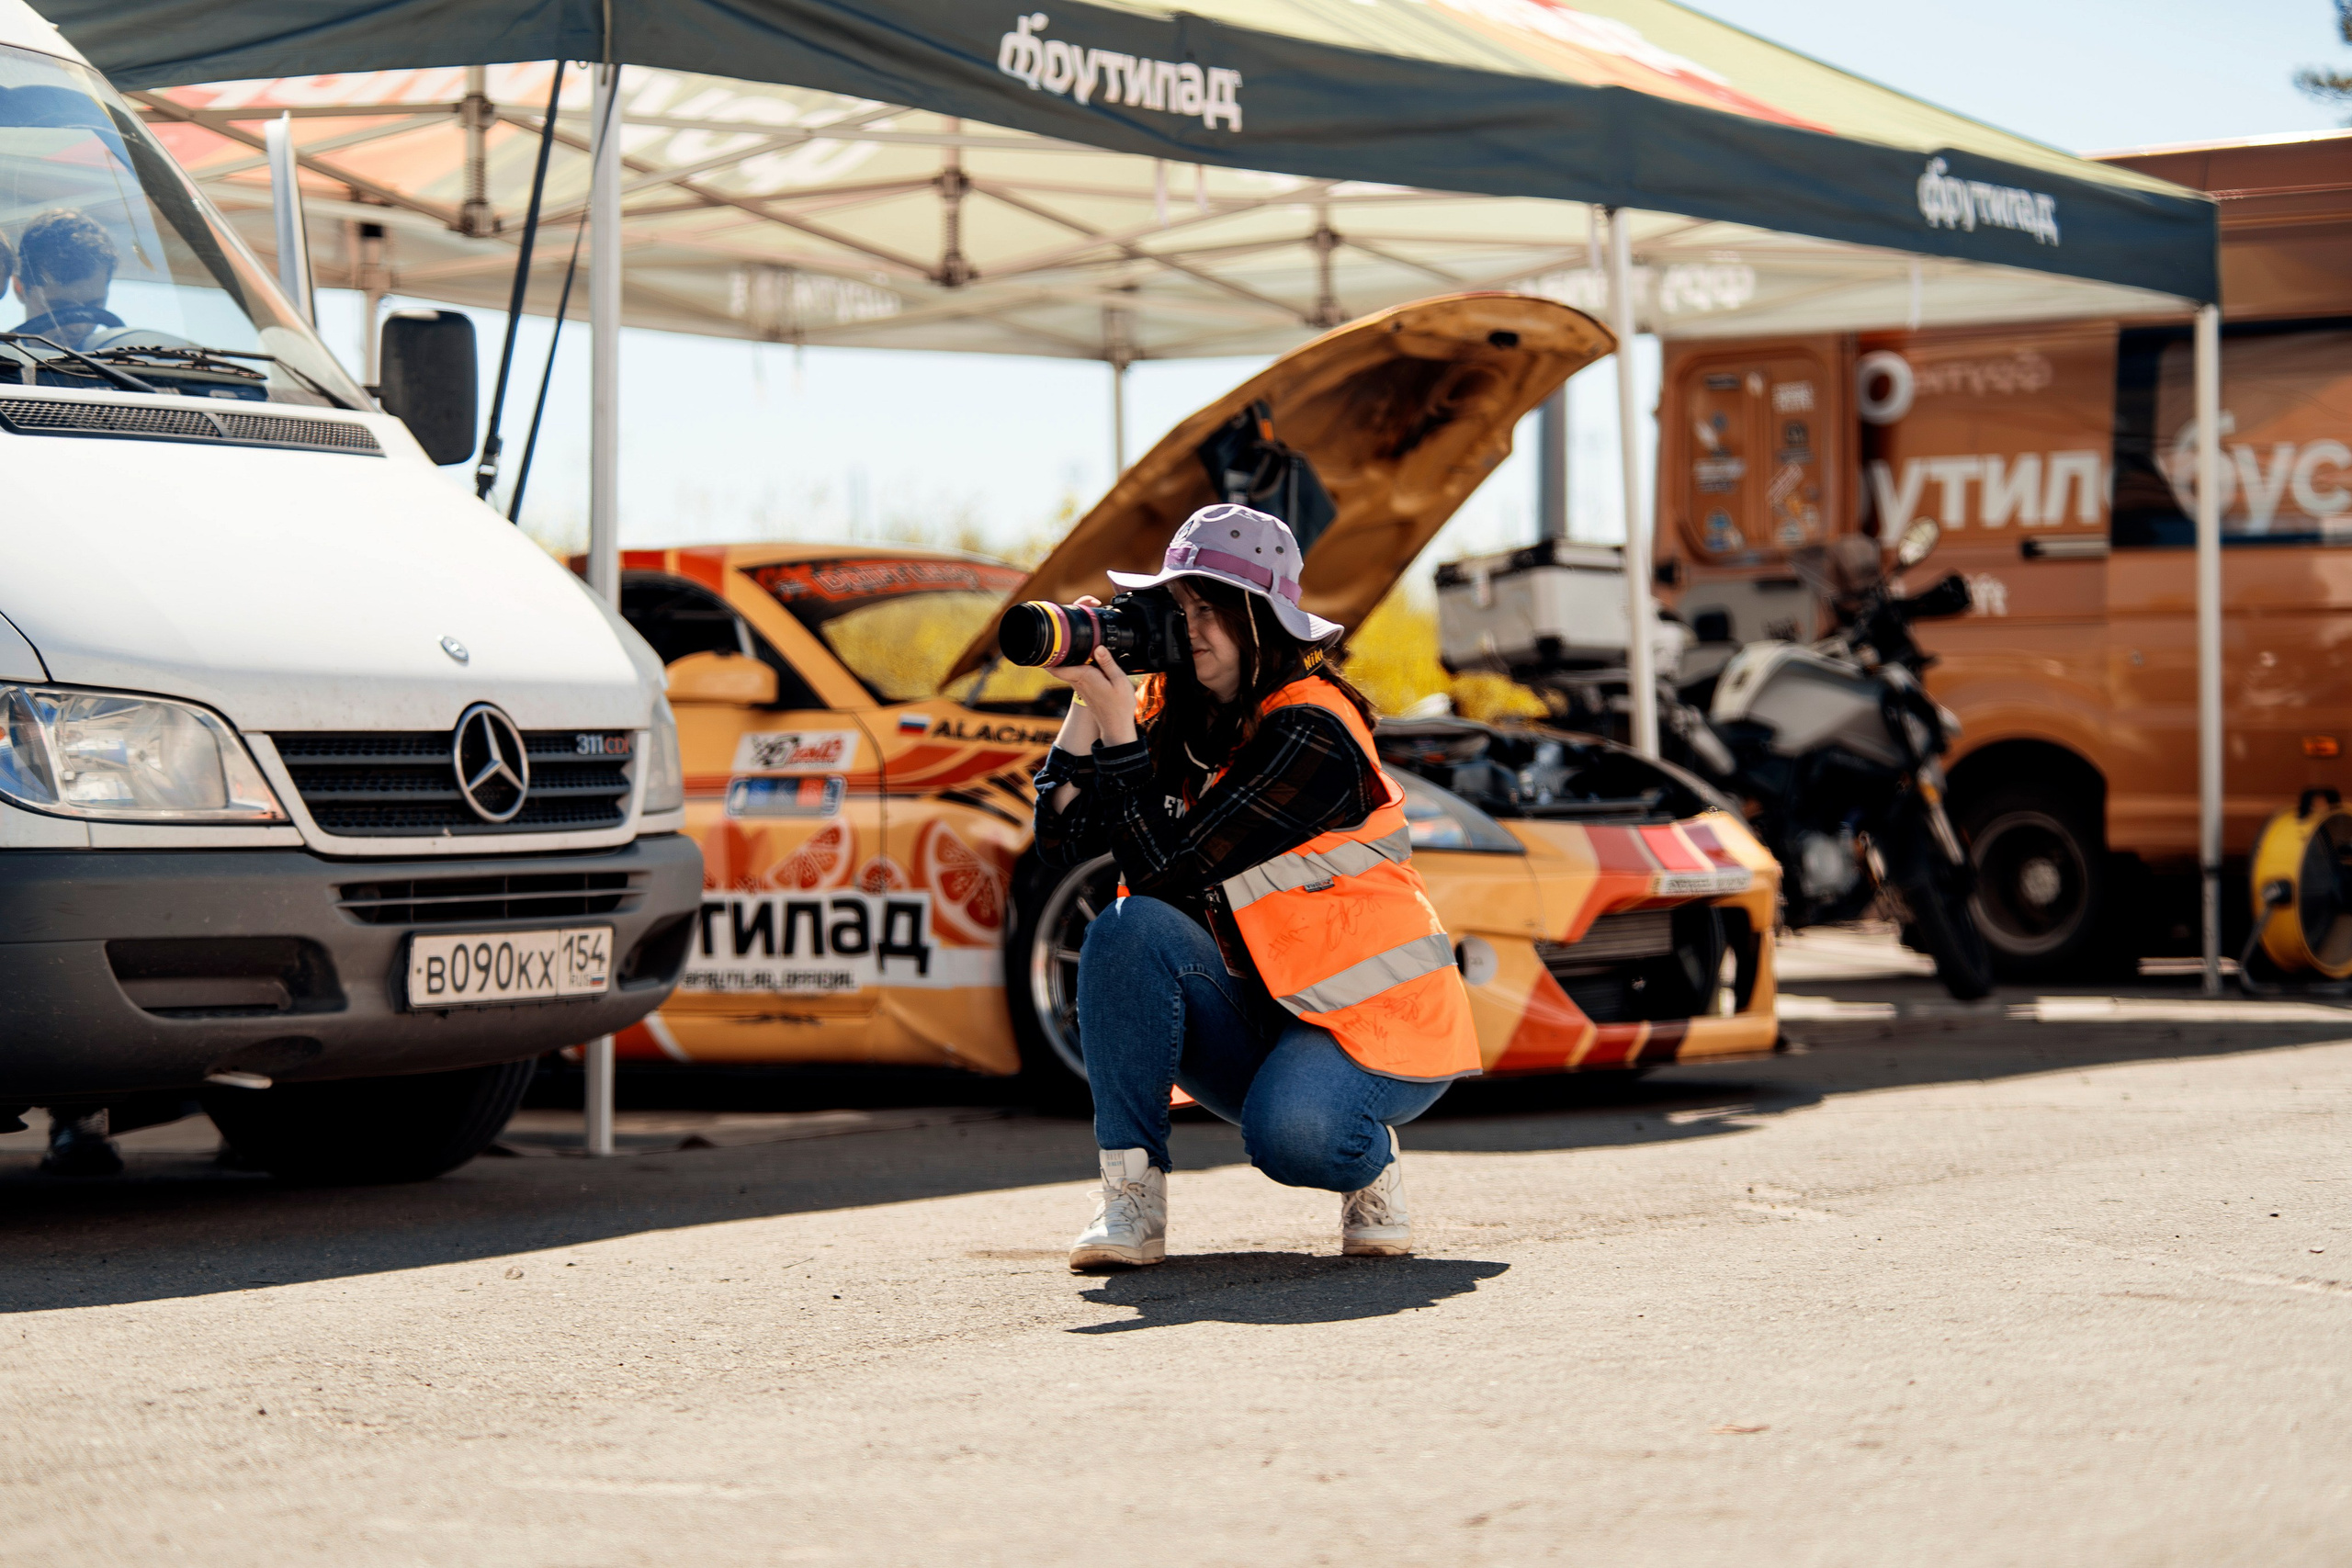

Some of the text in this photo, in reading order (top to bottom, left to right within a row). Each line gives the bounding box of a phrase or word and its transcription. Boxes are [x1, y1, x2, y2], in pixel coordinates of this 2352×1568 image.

[1871, 448, 2110, 548] утил
[1304, 648, 1323, 671] Nik
[562, 933, 605, 972] 154
